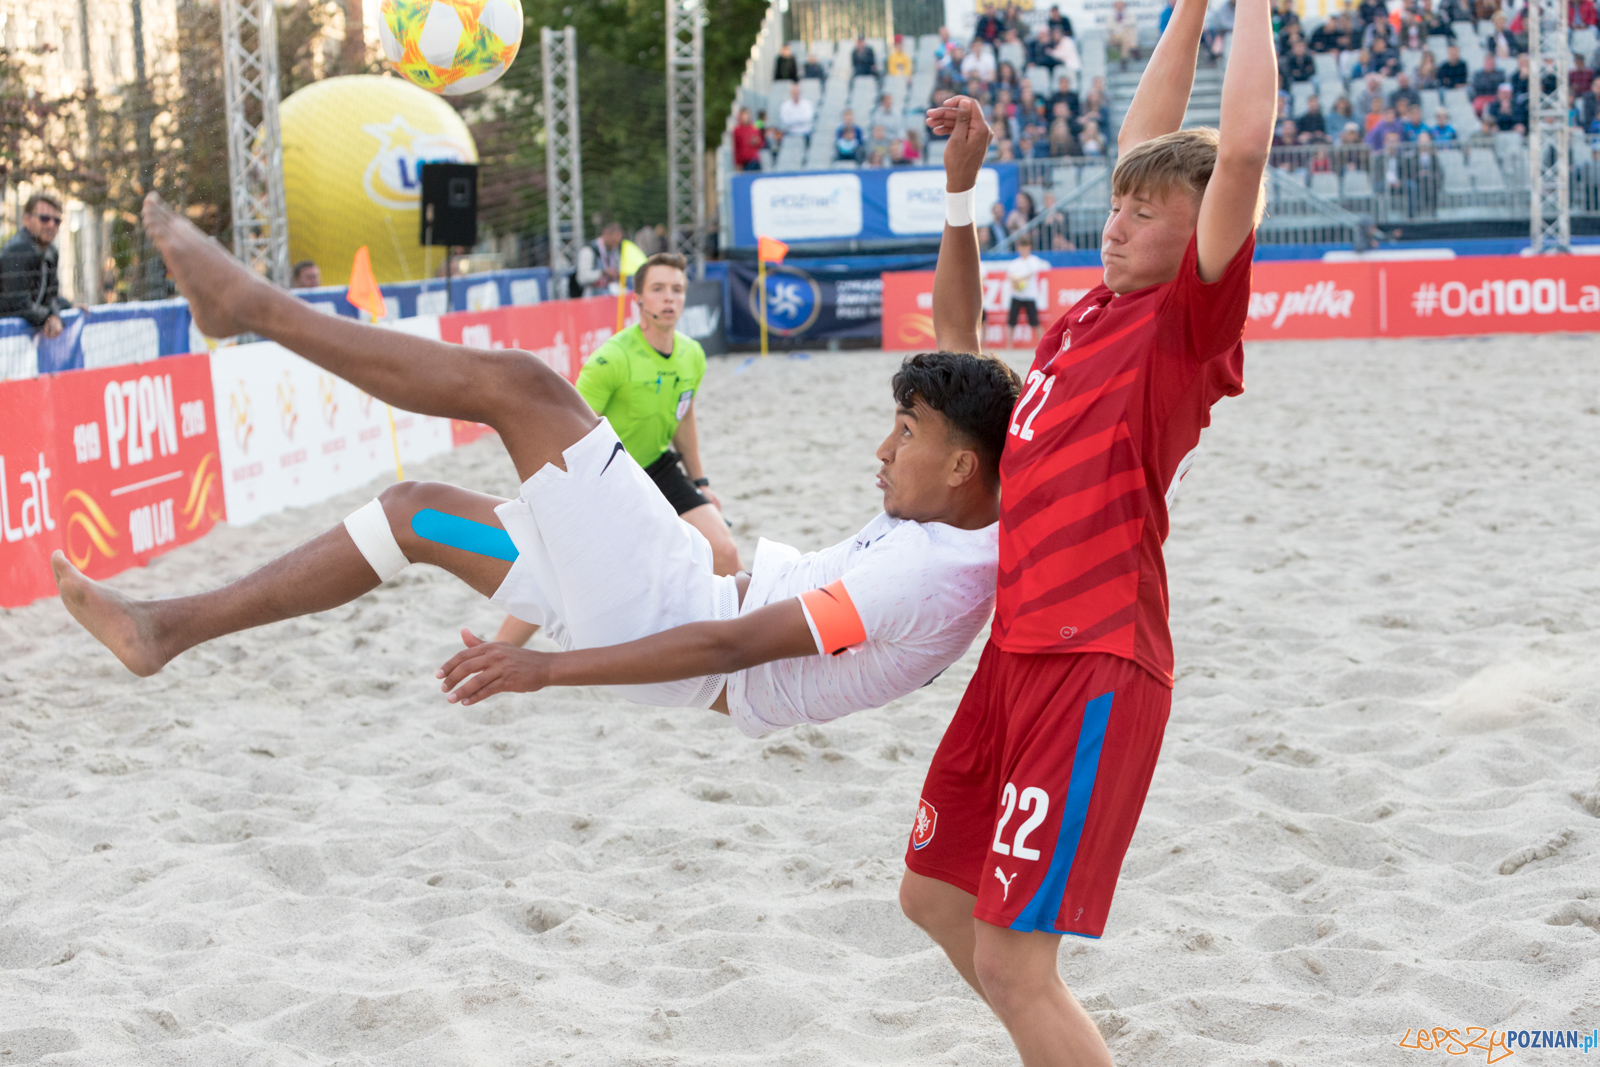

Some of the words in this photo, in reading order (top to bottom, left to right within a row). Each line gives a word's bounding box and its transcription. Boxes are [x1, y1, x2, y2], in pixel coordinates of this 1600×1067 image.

[1248, 291, 1279, 321] as
[1411, 278, 1600, 317] #Od100La
[103, 373, 179, 470] PZPN
[1009, 369, 1057, 442] 22
[0, 452, 56, 543] Lat
[151, 498, 176, 547] LAT
[992, 782, 1050, 861] 22
